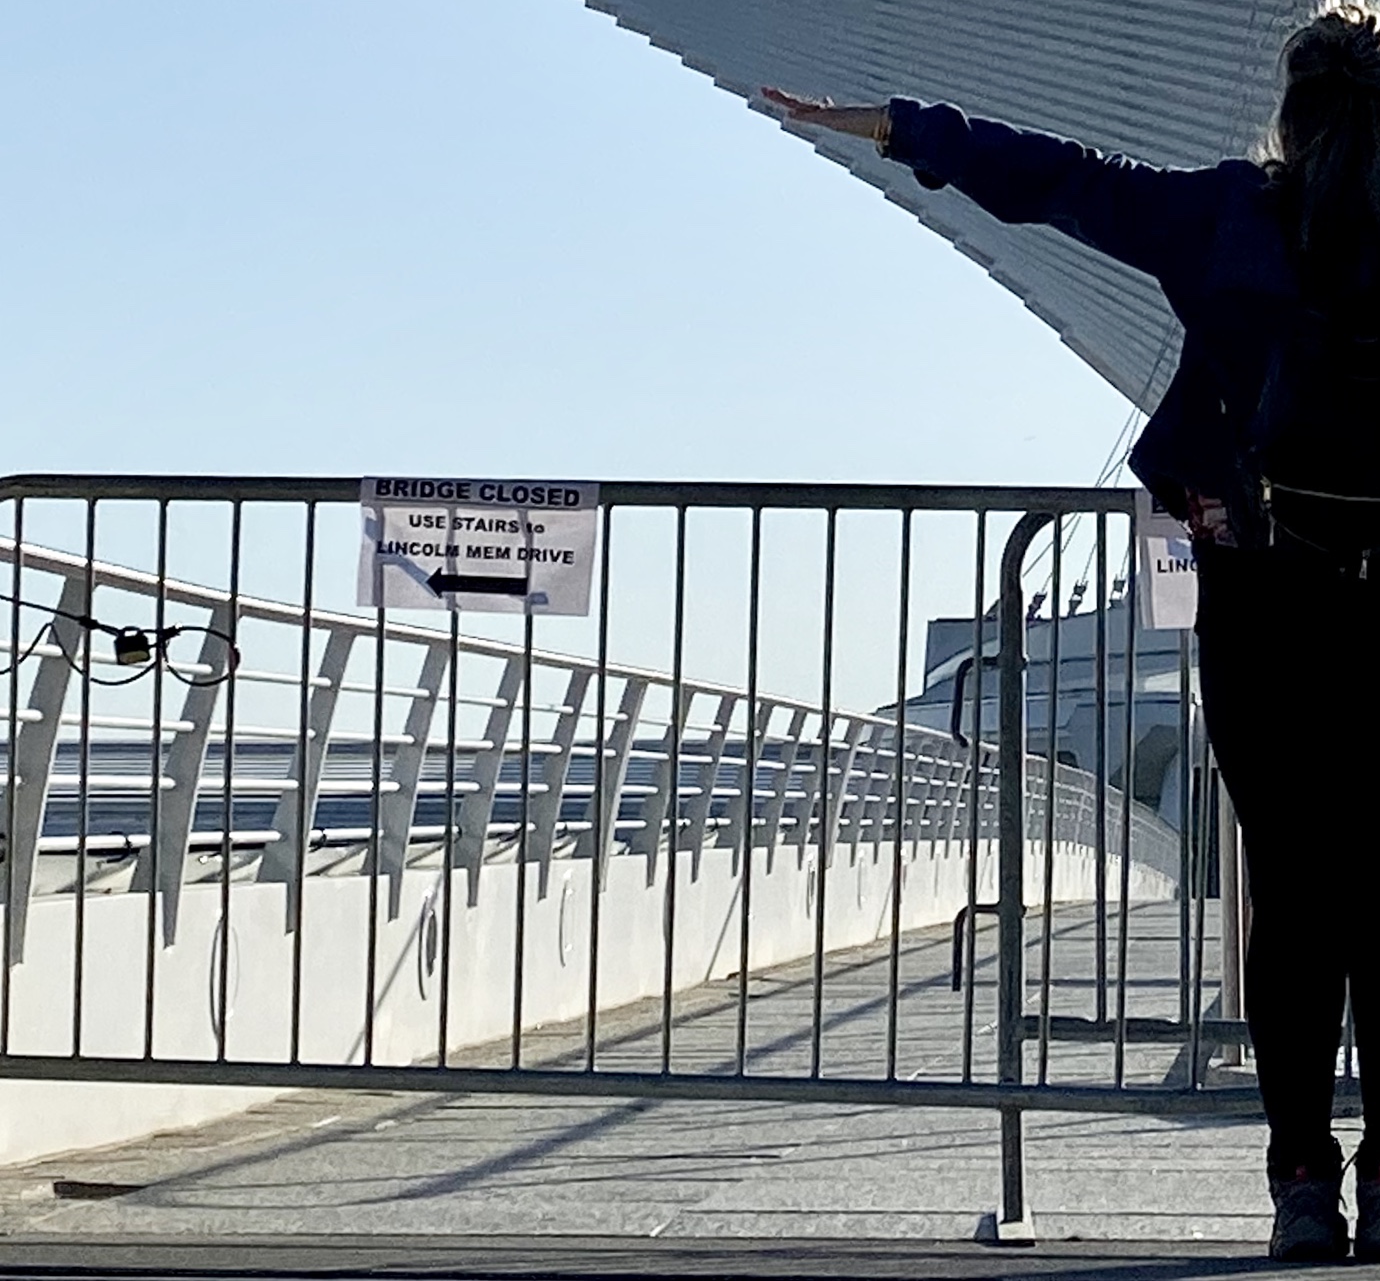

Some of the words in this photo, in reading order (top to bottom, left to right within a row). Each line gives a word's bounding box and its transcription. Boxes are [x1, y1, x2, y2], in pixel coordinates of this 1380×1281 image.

[375, 479, 472, 500] BRIDGE
[479, 483, 580, 507] CLOSED
[409, 514, 447, 530] USE
[452, 516, 520, 534] STAIRS
[526, 520, 545, 534] to
[466, 544, 511, 560] MEM
[517, 547, 575, 565] DRIVE
